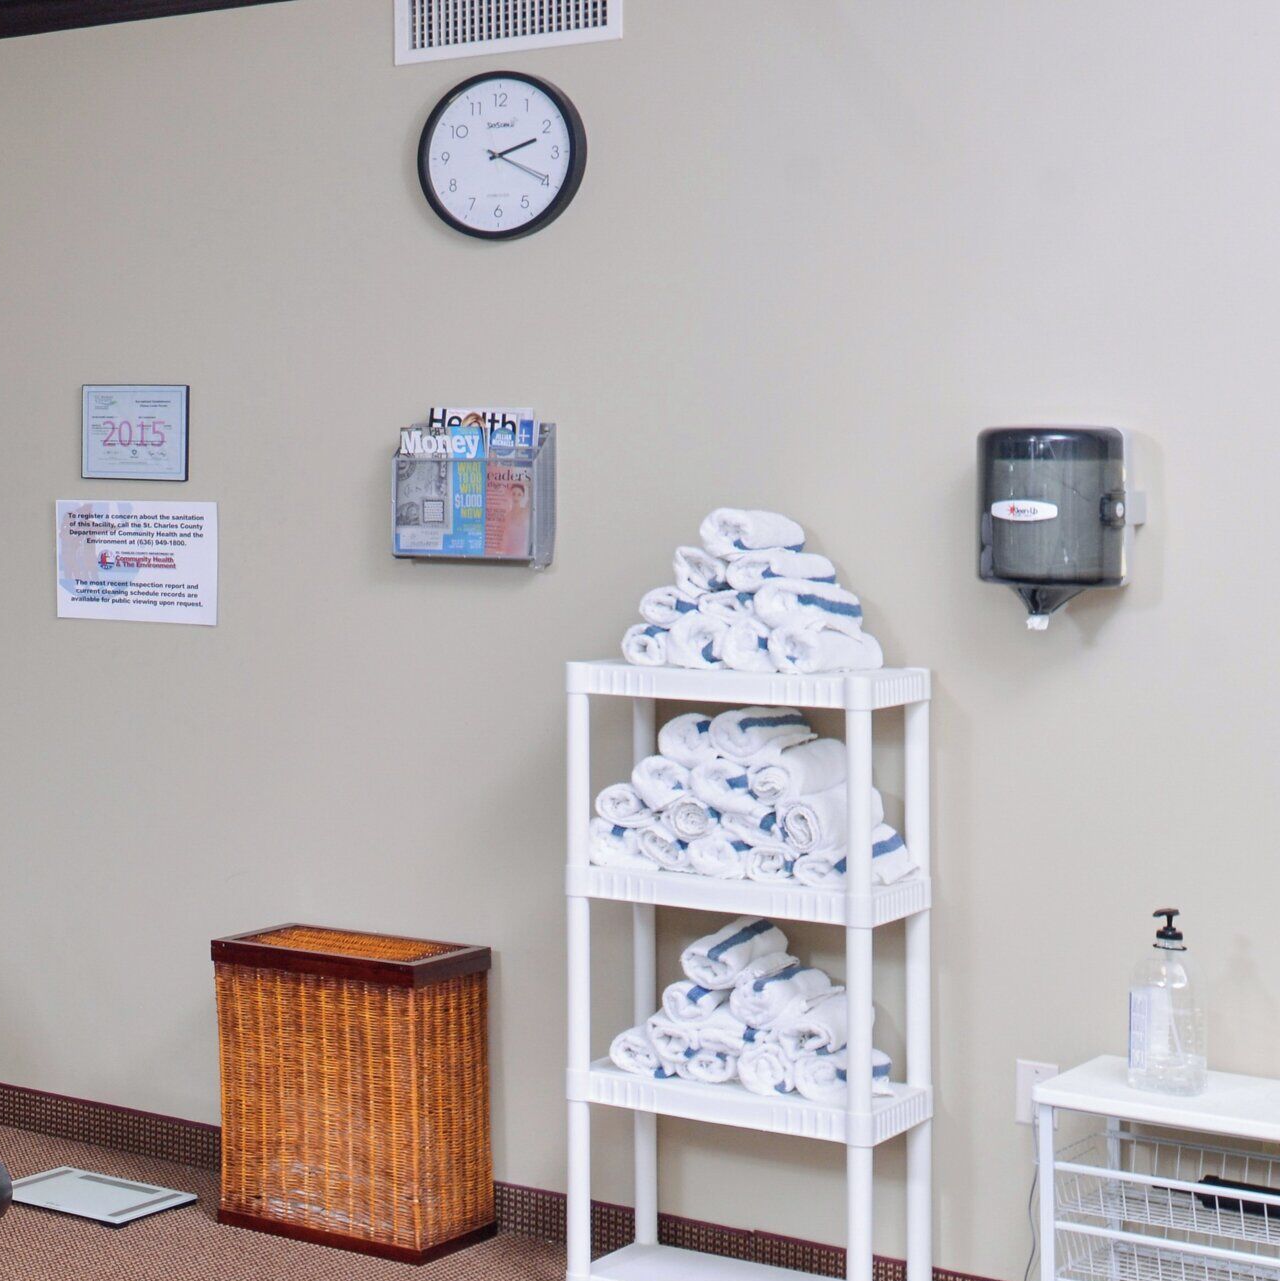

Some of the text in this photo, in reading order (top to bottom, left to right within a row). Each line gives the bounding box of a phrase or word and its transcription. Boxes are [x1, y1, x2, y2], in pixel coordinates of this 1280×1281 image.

[493, 93, 508, 107] 12
[524, 99, 529, 112] 1
[470, 102, 482, 115] 11
[451, 124, 468, 139] 10
[542, 120, 551, 133] 2
[441, 152, 450, 165] 9
[551, 146, 559, 159] 3
[449, 179, 457, 192] 8
[541, 175, 549, 187] 4
[469, 198, 476, 210] 7
[521, 195, 529, 208] 5
[494, 205, 503, 217] 6
[429, 408, 516, 435] Helth
[102, 420, 166, 447] 2015
[400, 430, 480, 458] Money
[133, 598, 157, 606] viewing
[177, 600, 203, 608] request.
